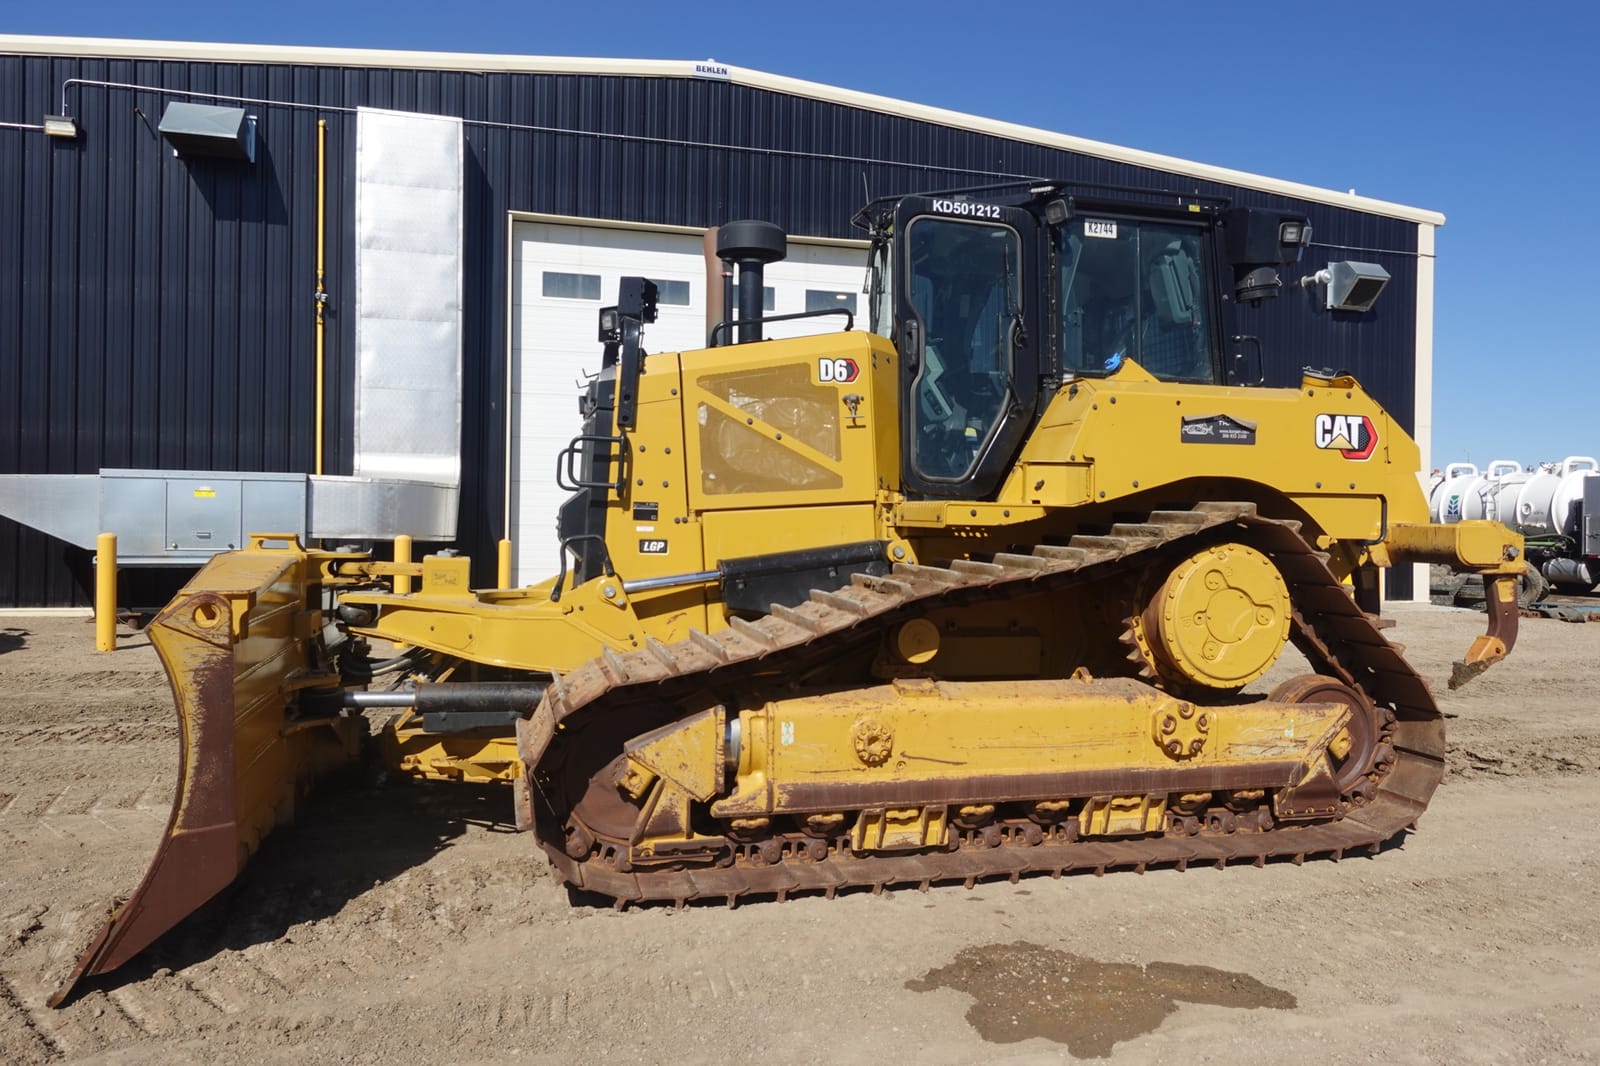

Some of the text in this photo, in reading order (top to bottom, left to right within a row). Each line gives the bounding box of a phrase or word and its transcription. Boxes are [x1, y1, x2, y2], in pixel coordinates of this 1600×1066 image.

[695, 64, 728, 75] BEHLEN
[932, 199, 1000, 219] KD501212
[819, 358, 848, 382] D6
[1315, 414, 1363, 450] CAT
[643, 541, 665, 552] LGP
